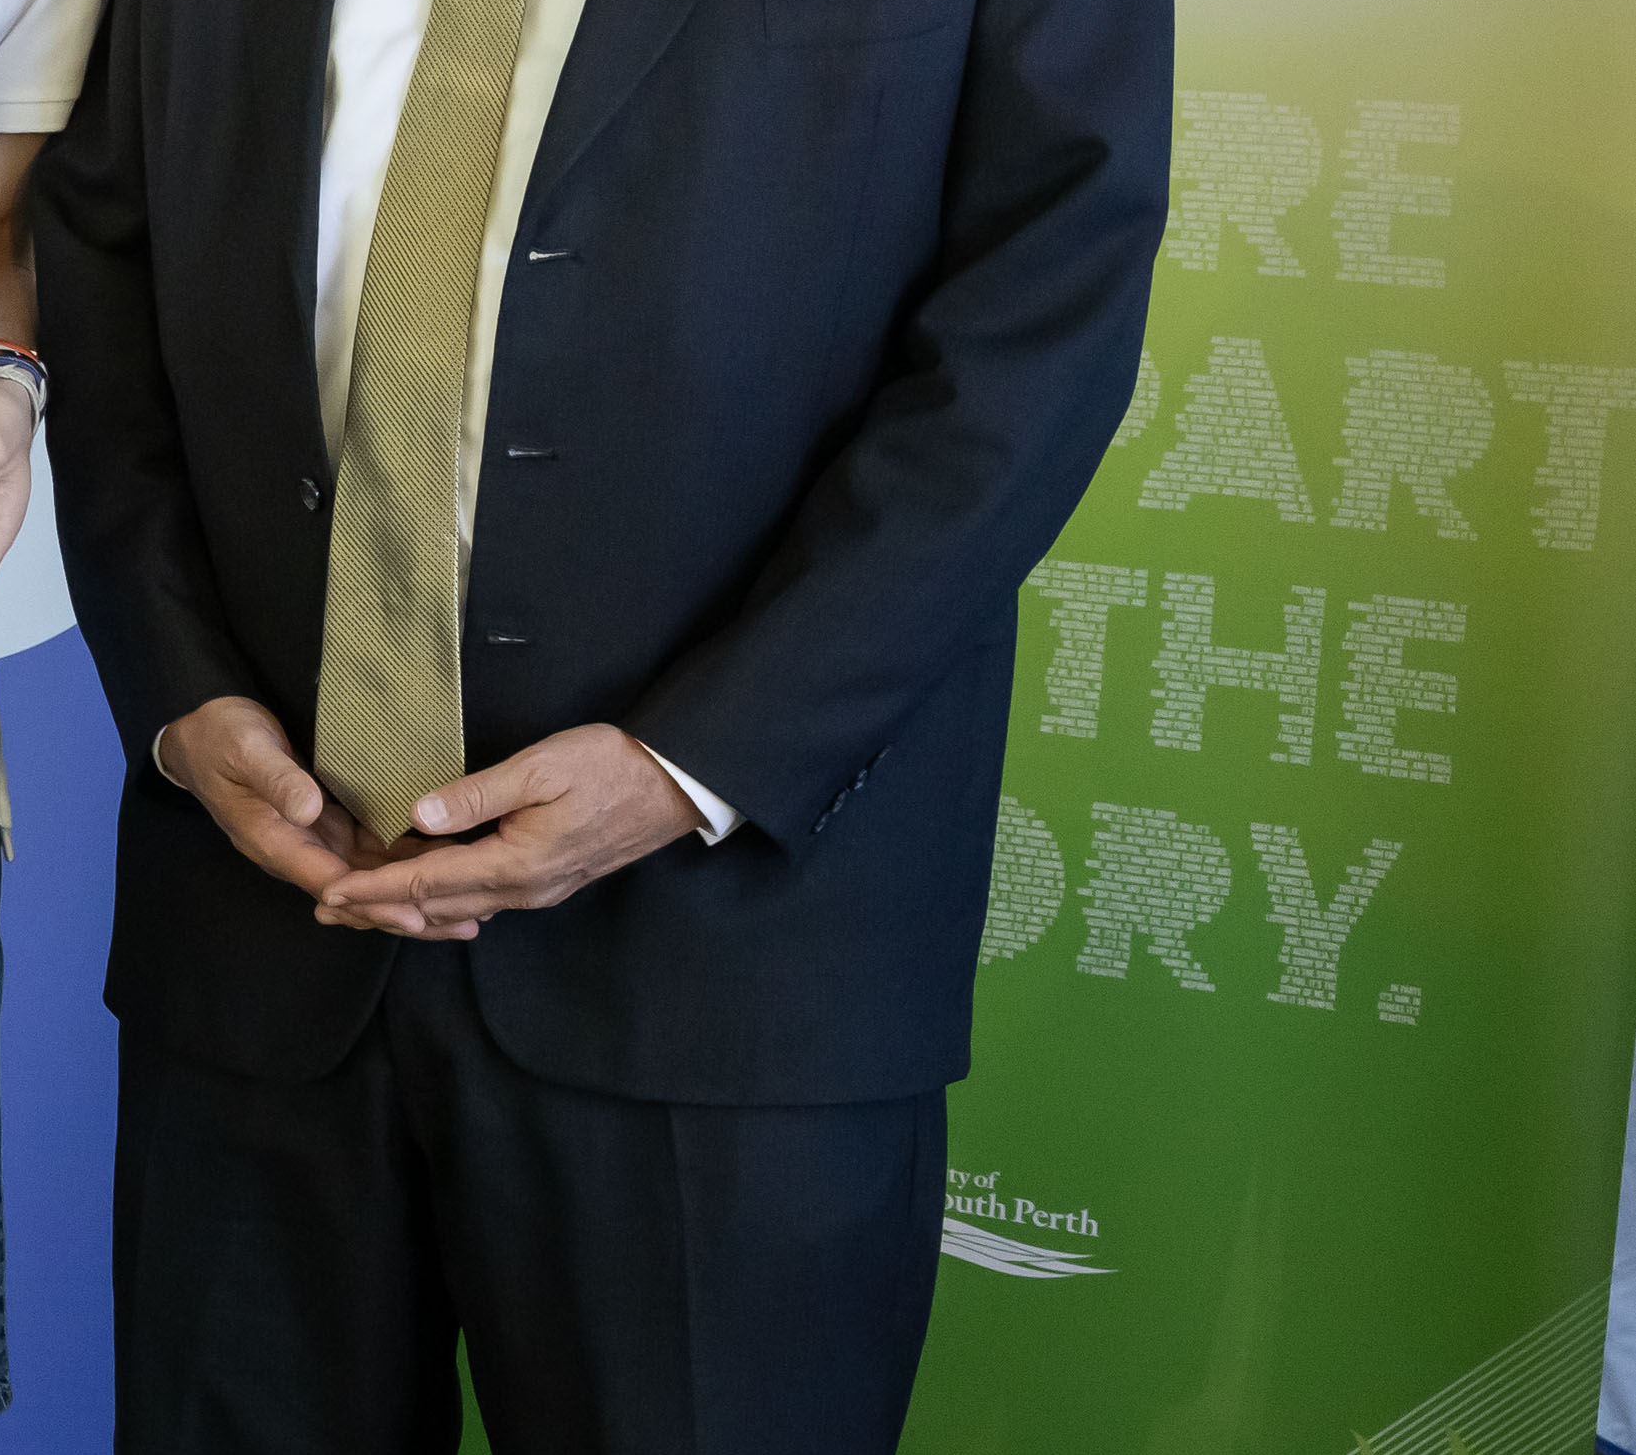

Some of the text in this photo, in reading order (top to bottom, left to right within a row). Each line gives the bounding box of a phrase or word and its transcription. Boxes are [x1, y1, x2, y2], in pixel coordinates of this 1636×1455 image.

[1110, 336, 1636, 551] ART
[1027, 559, 1467, 784] THE
[944, 1193, 1099, 1237] outh Perth
[973, 1171, 1000, 1190] of
